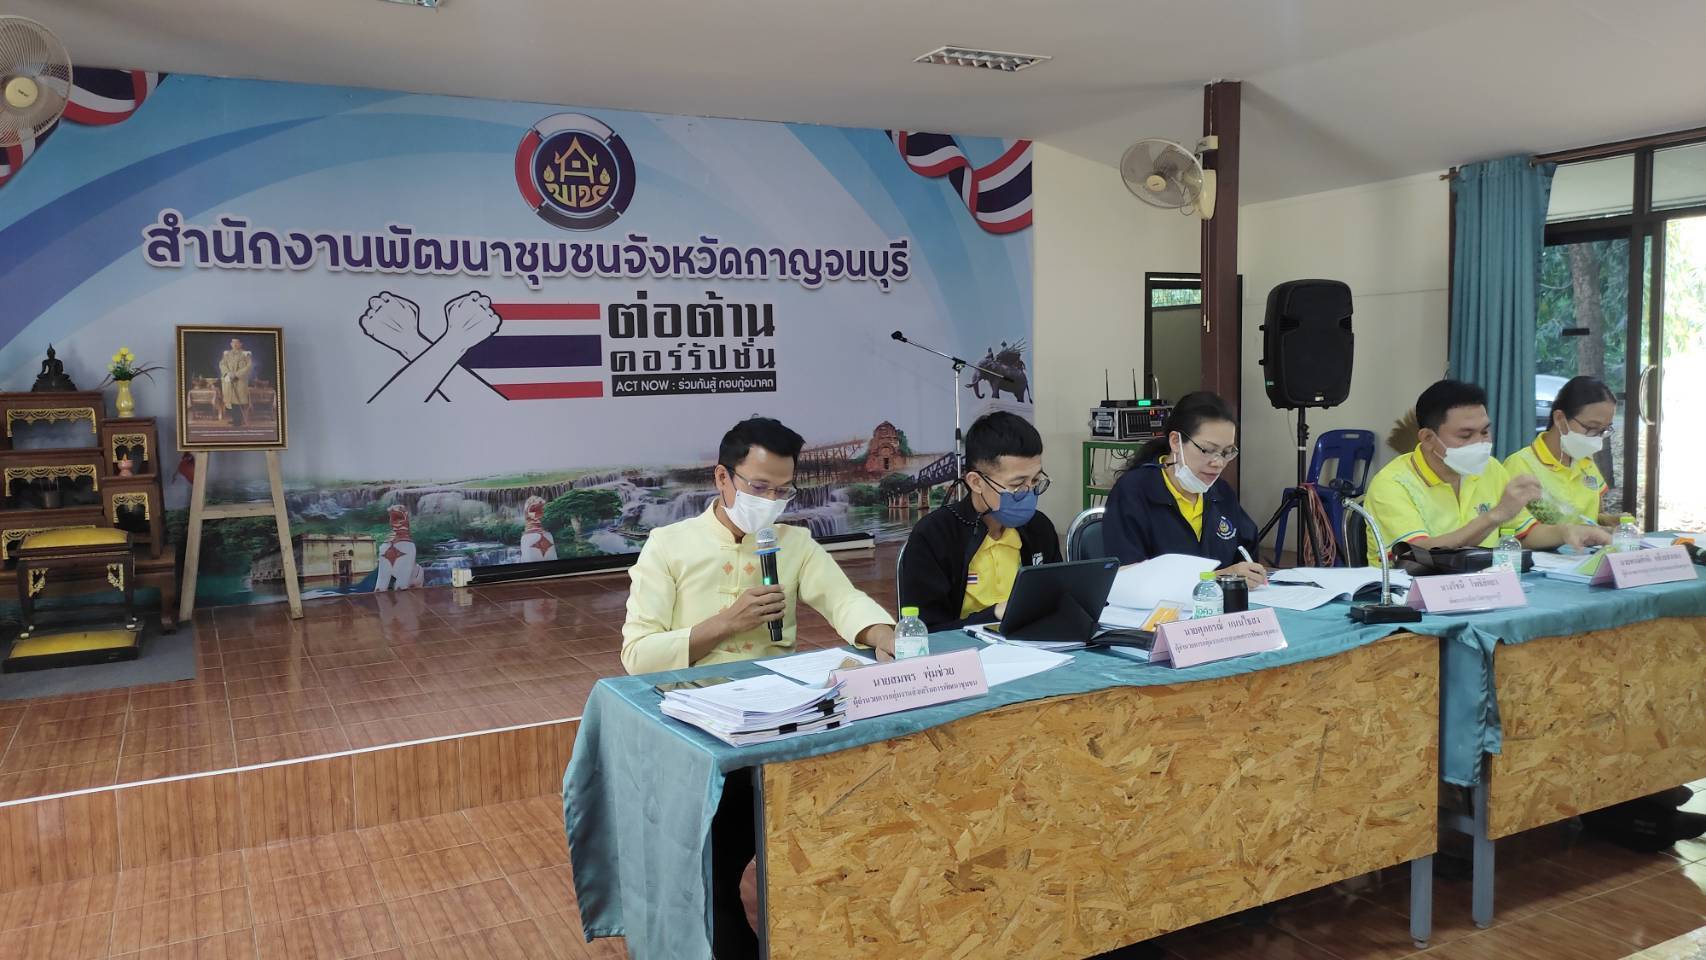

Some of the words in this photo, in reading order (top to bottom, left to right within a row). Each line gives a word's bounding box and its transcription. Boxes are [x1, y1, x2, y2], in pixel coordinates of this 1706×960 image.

[146, 212, 909, 289] สำนักงานพัฒนาชุมชนจังหวัดกาญจนบุรี
[607, 290, 776, 338] ต่อต้าน
[615, 380, 638, 392] ACT
[641, 380, 669, 391] NOW
[678, 377, 717, 393] ร่วมกันสู้
